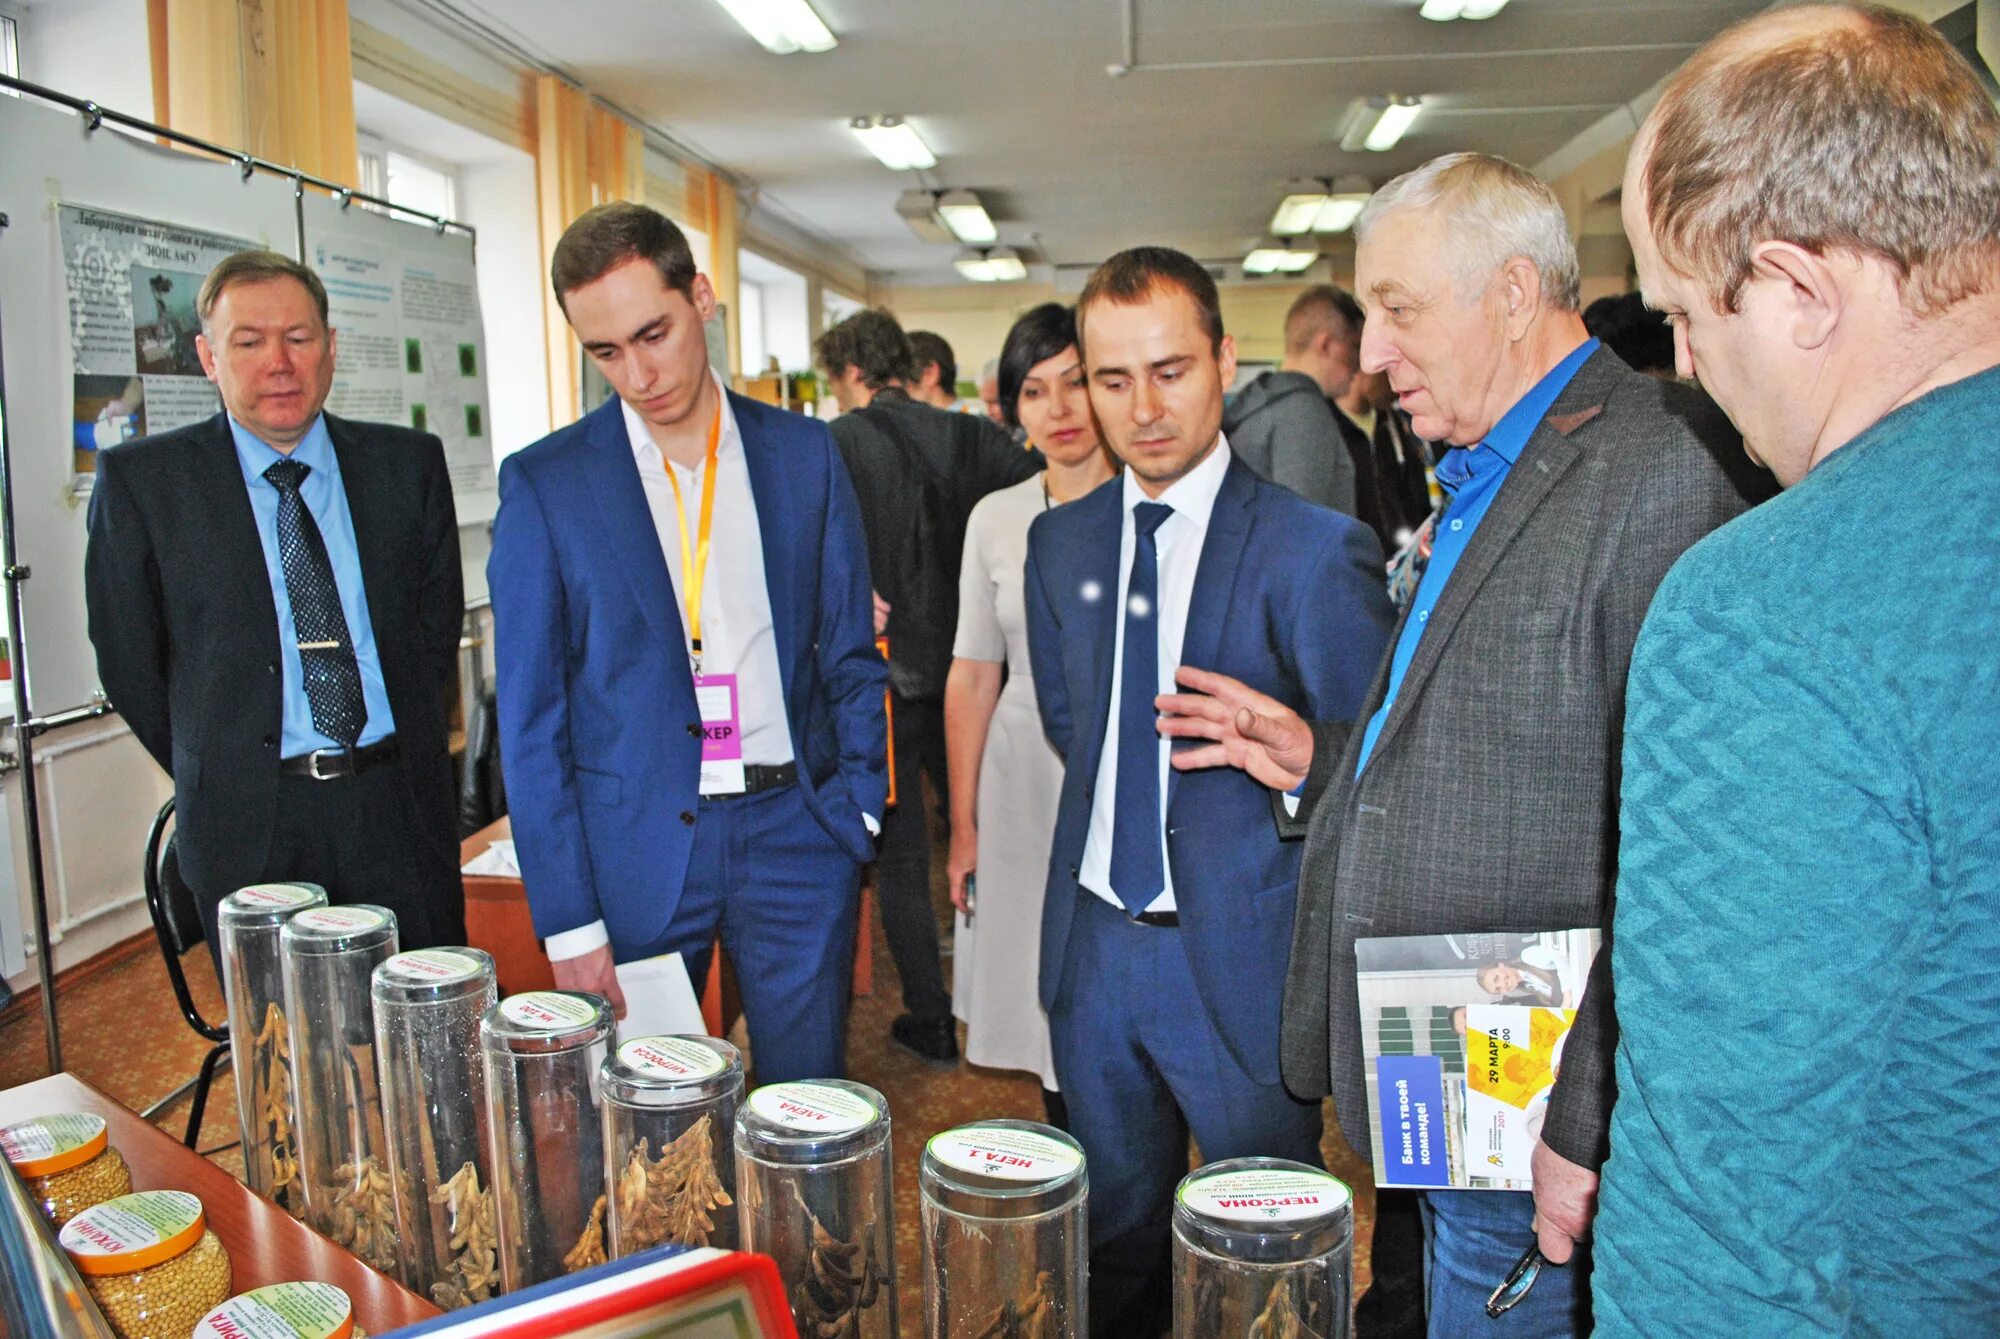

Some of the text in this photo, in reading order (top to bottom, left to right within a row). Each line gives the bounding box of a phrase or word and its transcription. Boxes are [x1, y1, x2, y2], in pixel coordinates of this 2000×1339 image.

[1489, 1028, 1498, 1083] 29 МАРТА
[1502, 1028, 1510, 1049] 9:00
[1395, 1079, 1414, 1165] Банк в твоей
[1414, 1102, 1430, 1165] команде!
[969, 1149, 1033, 1168] НЕГА 1
[1218, 1196, 1319, 1208] ПЕРСОНА
